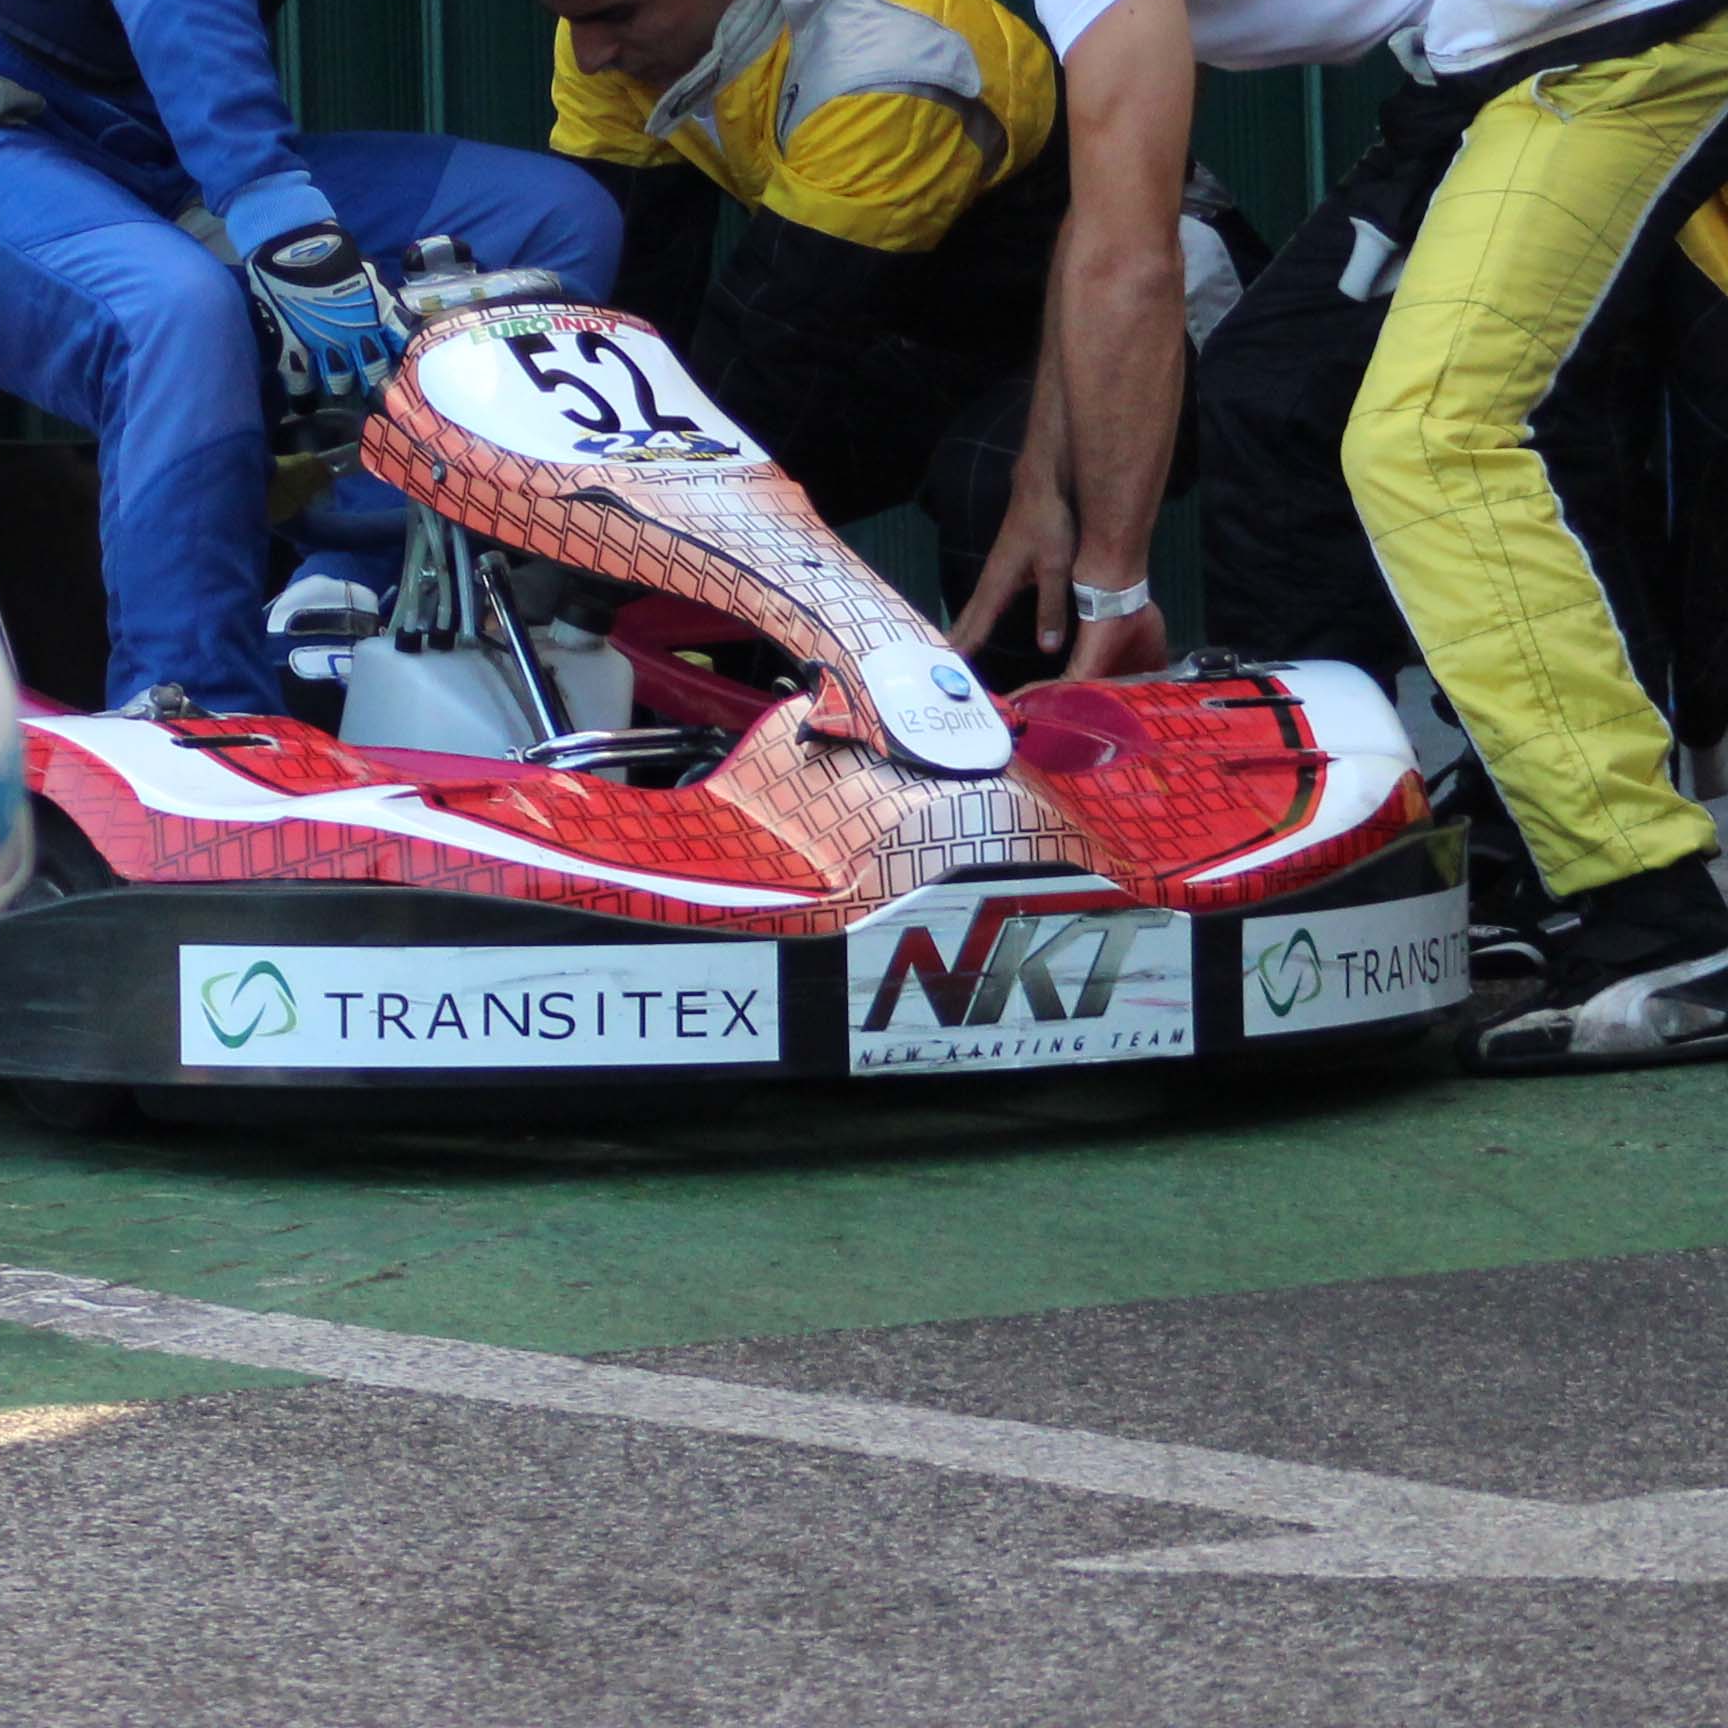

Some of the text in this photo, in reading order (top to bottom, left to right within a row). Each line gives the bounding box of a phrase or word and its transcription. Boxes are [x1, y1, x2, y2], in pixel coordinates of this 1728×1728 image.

[469, 315, 621, 345] EUROINDY
[503, 331, 703, 433] 52
[589, 430, 693, 454] 24
[923, 705, 993, 735] Spirit
[860, 888, 1175, 1033] NKT
[324, 989, 760, 1041] TRANSITEX
[858, 1029, 1186, 1066] NEW KARTING TEAM
